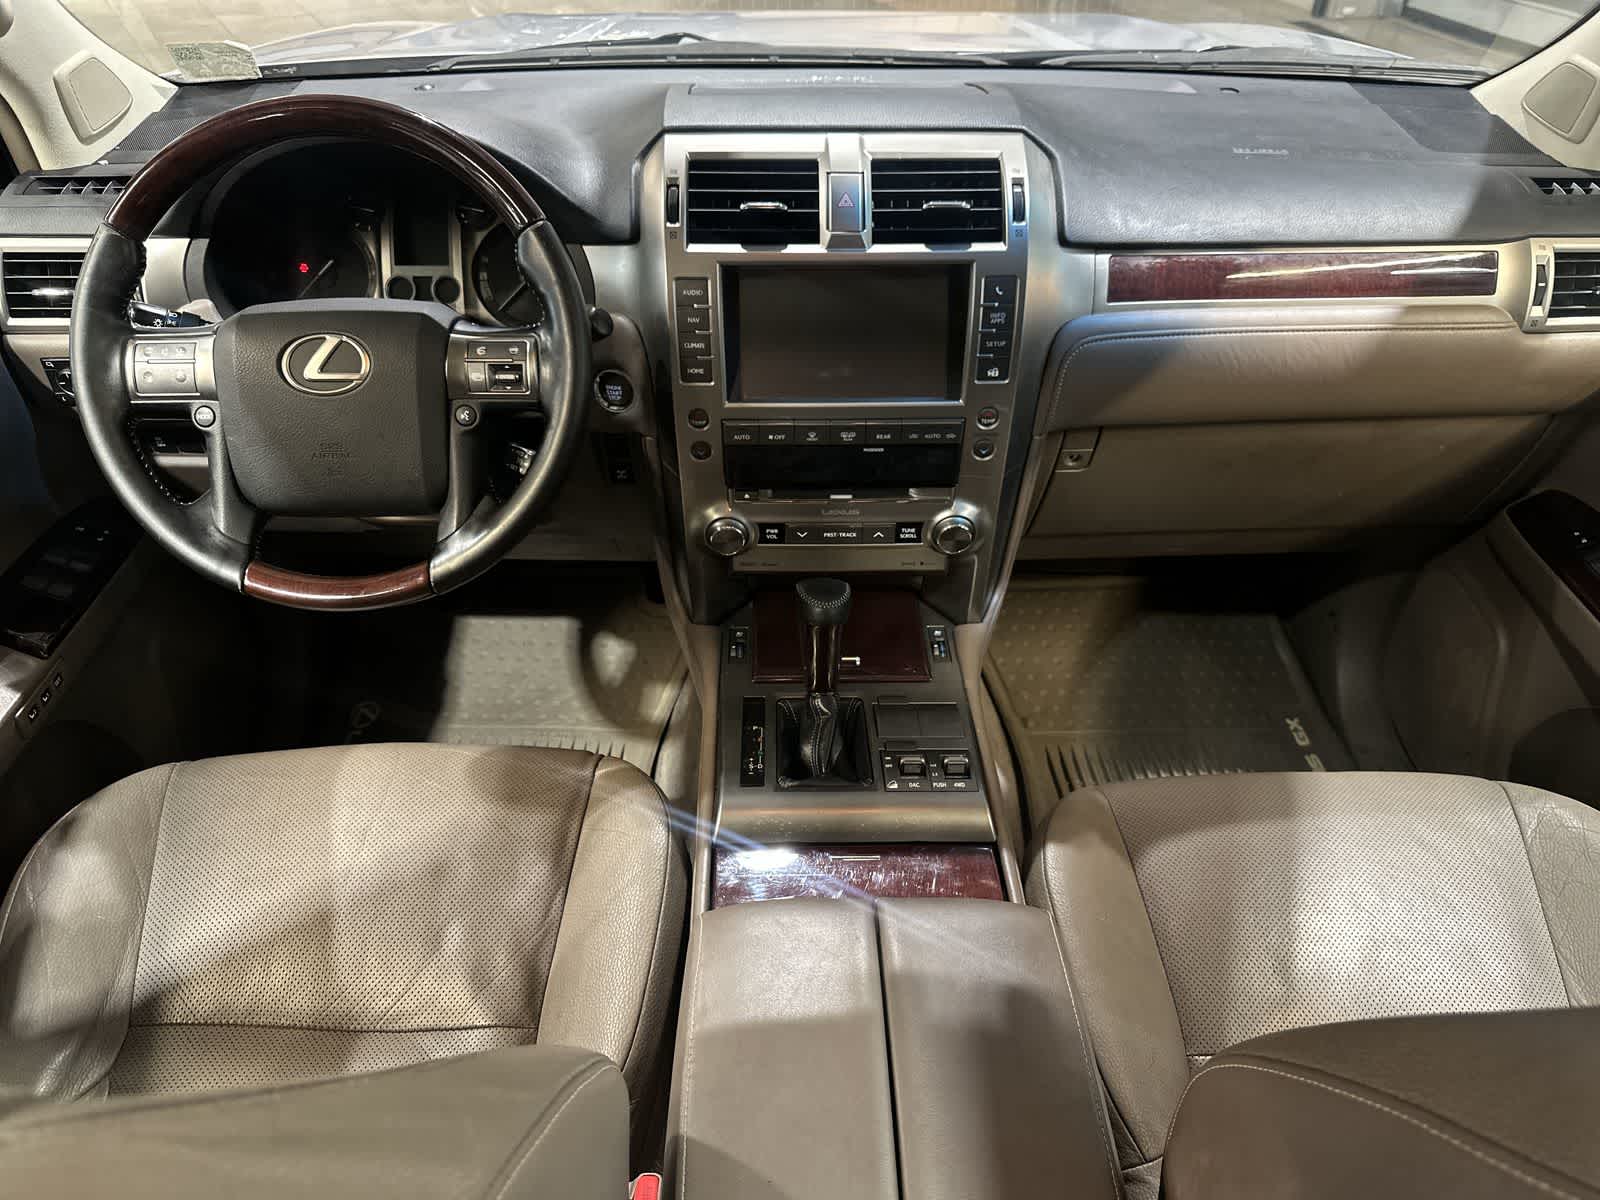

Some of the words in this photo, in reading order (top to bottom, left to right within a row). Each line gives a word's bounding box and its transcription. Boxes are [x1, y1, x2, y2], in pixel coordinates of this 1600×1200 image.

[733, 433, 751, 441] AUTO
[773, 433, 786, 441] OFF
[1284, 717, 1311, 747] GX
